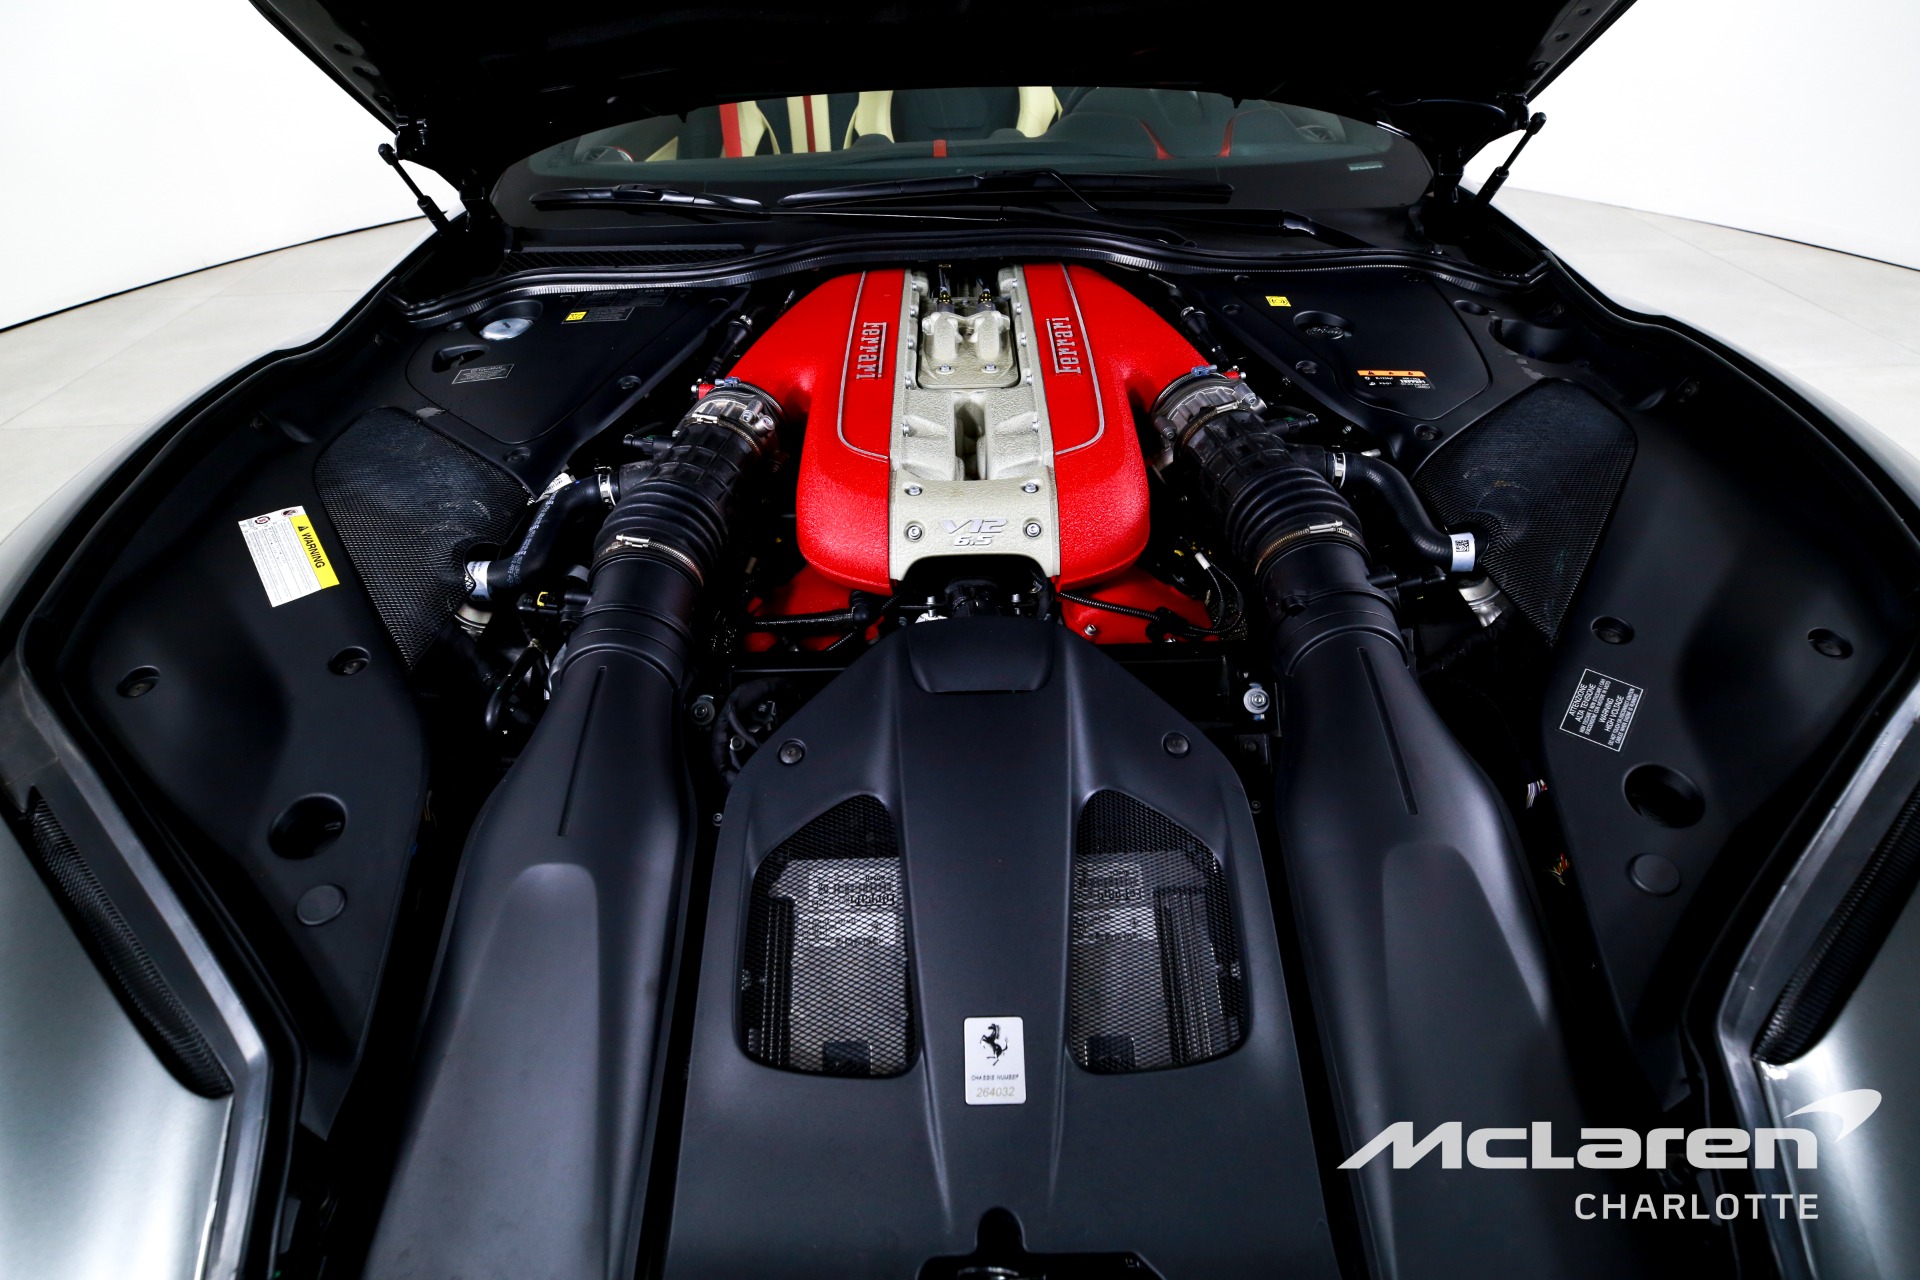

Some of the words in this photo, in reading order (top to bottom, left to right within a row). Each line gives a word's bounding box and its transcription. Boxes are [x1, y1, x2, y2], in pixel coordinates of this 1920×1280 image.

[856, 322, 886, 379] Ferrari
[1046, 317, 1081, 374] Ferrari
[940, 518, 1008, 534] V12
[954, 536, 992, 546] 6.5
[302, 532, 326, 568] WARNING
[1569, 684, 1588, 716] ATTENZIONE
[1575, 709, 1585, 722] ALTA
[1580, 684, 1596, 709] TENSIONE
[1599, 698, 1614, 724] WARNING
[1604, 718, 1615, 732] HIGH
[1610, 695, 1624, 718] VOLTAGE
[976, 1086, 1015, 1098] 264032
